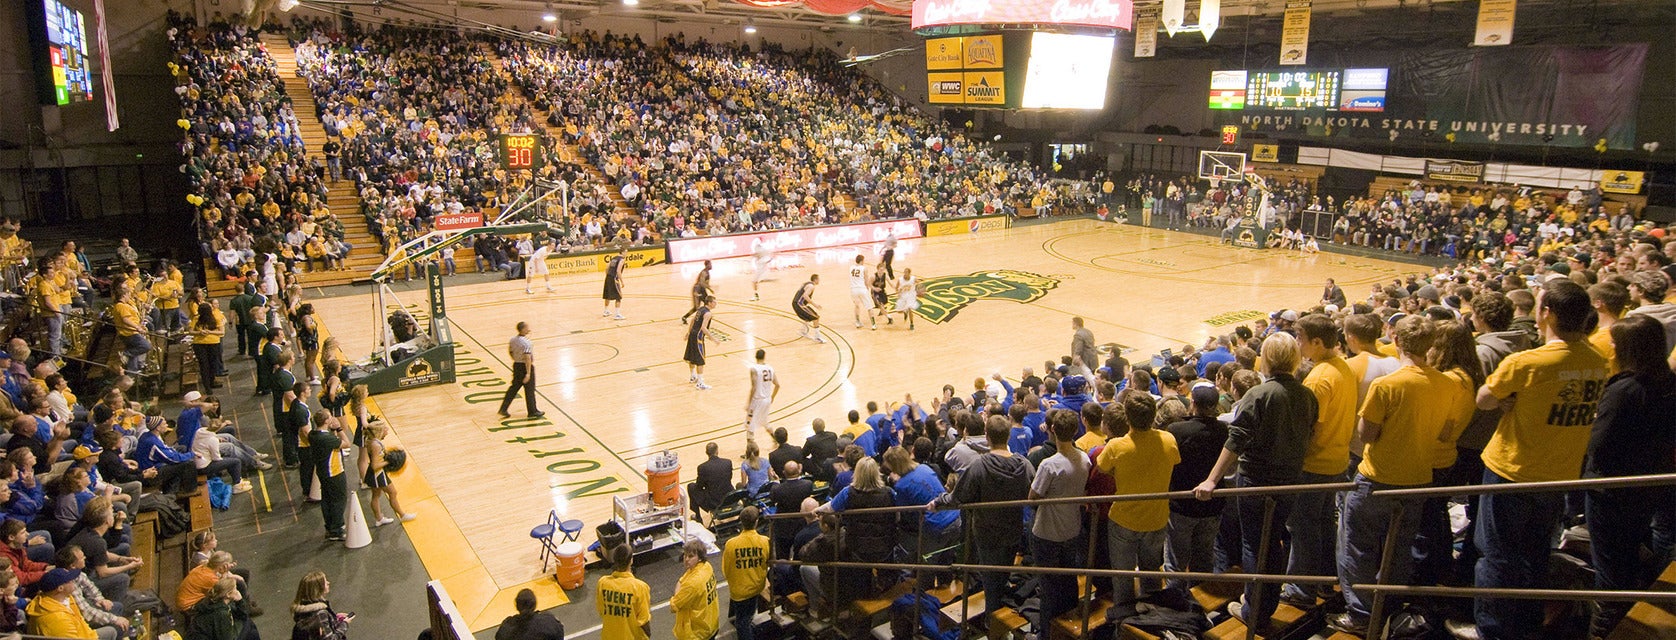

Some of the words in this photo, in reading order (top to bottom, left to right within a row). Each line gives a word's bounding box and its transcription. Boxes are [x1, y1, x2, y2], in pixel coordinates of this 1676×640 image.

[1279, 72, 1307, 82] 10:02
[942, 82, 961, 90] WWC
[1271, 87, 1281, 96] 10
[1301, 87, 1311, 96] 15
[967, 87, 1000, 97] SUMMIT
[1242, 115, 1292, 125] NORTH
[1303, 116, 1370, 128] DAKOTA
[1382, 118, 1438, 130] STATE
[1451, 120, 1587, 136] UNIVERSITY
[507, 137, 534, 148] 10:02
[509, 148, 532, 166] 30
[981, 219, 1003, 229] pepsi
[559, 260, 573, 270] City
[575, 258, 595, 268] Bank
[851, 268, 861, 277] 42
[762, 369, 772, 382] 21
[486, 413, 630, 501] North
[735, 547, 763, 559] EVENT
[735, 557, 763, 570] STAFF
[602, 589, 634, 605] EVENT
